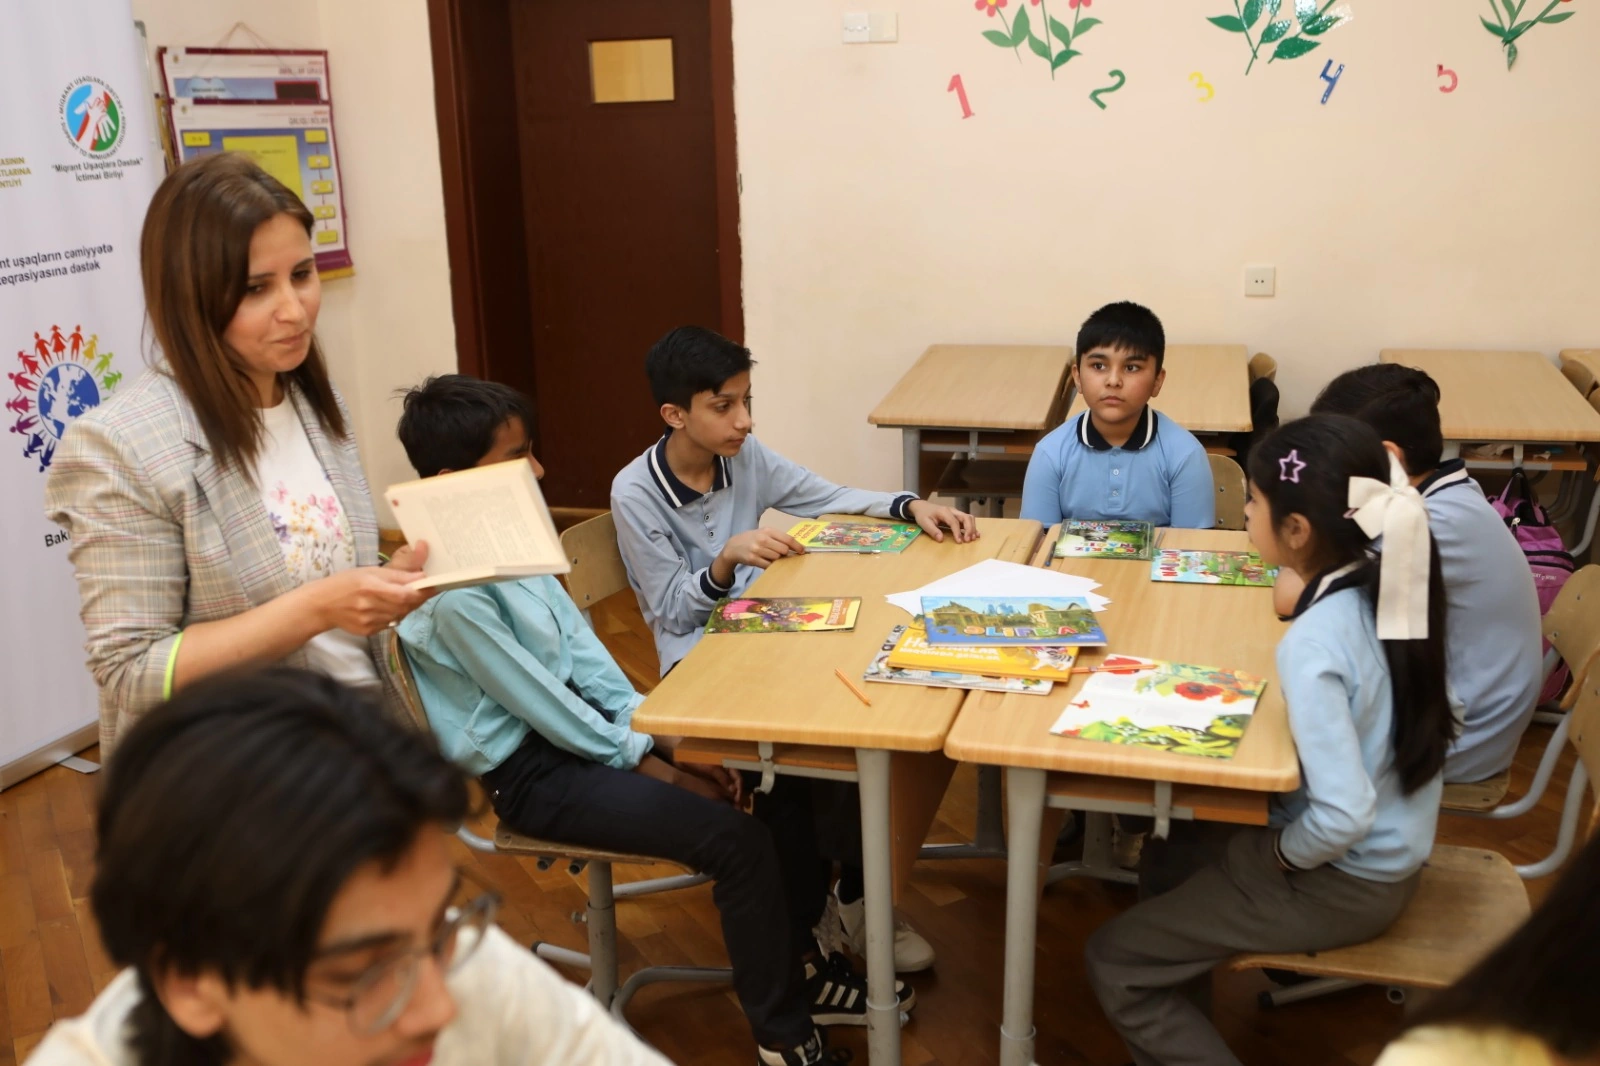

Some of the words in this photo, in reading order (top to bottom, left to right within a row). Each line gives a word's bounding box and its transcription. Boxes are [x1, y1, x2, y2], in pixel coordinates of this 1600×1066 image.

[947, 73, 975, 119] 1
[1089, 69, 1126, 110] 2
[1188, 71, 1214, 103] 3
[1319, 59, 1345, 105] 4
[1437, 64, 1458, 93] 5
[12, 251, 62, 269] uşaqların
[64, 244, 113, 258] cəmiyyətə
[70, 260, 101, 274] dəstək
